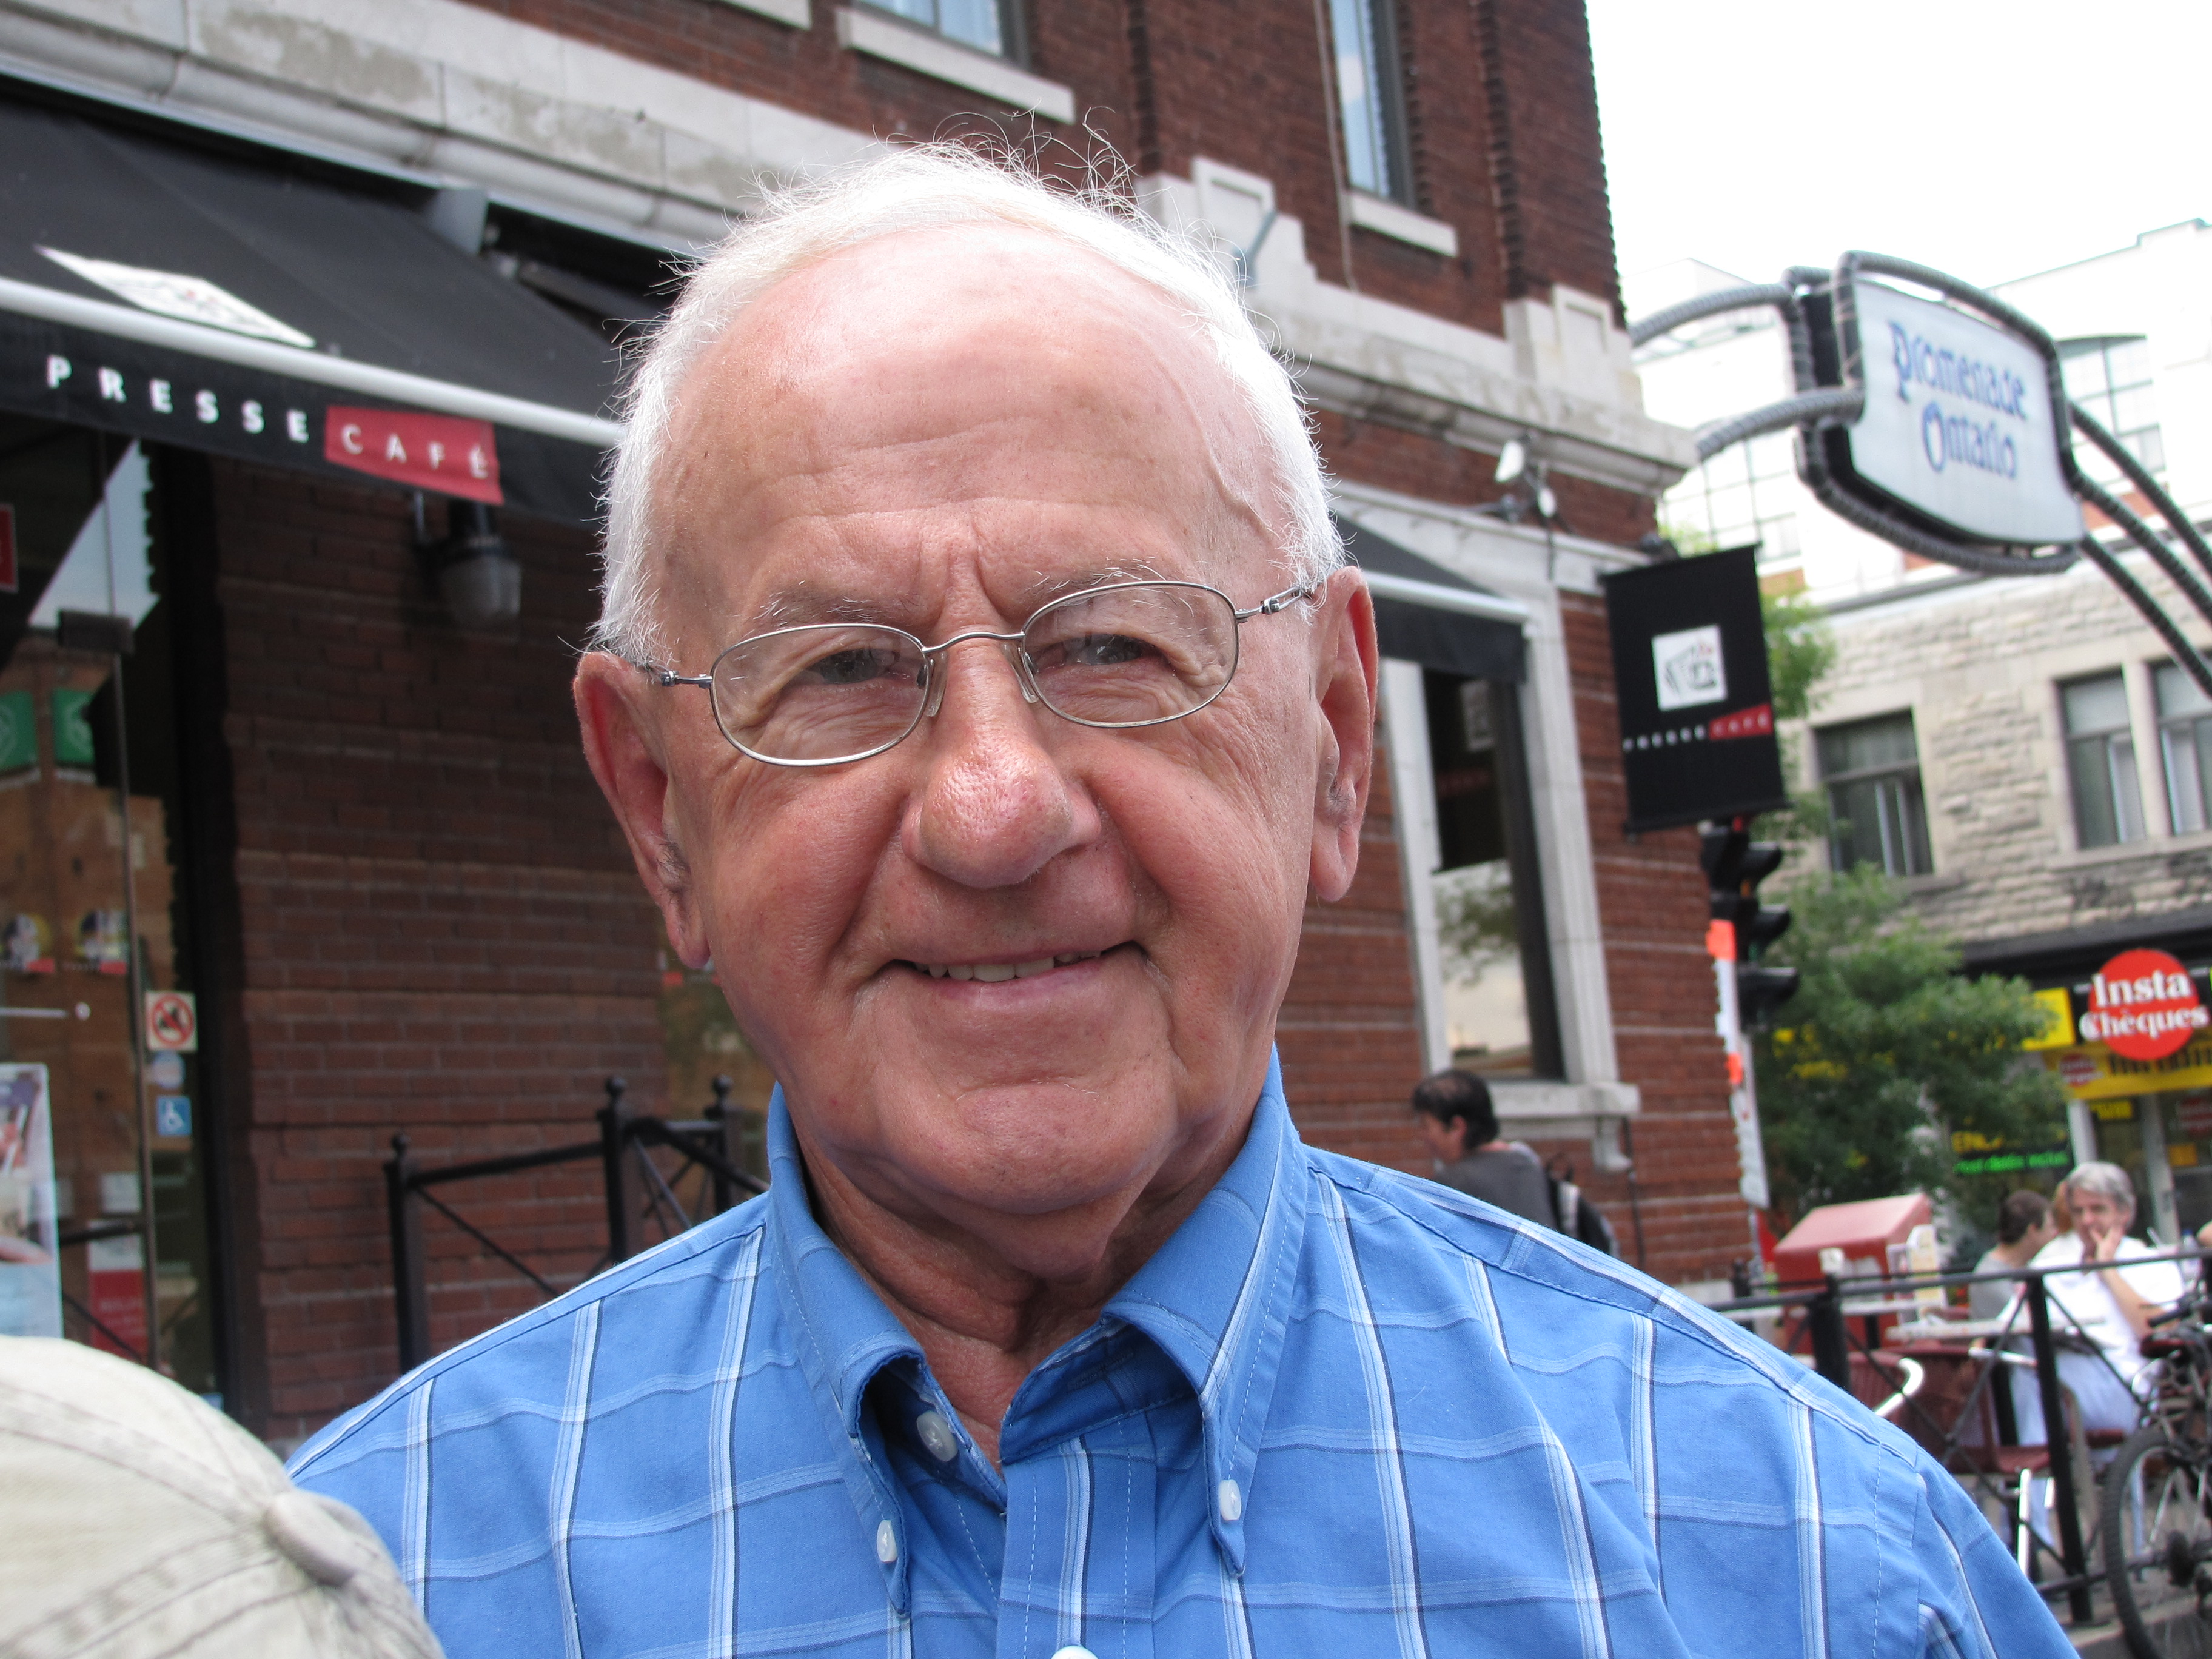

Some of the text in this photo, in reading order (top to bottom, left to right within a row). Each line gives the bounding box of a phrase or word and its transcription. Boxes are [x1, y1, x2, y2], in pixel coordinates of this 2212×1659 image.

[46, 354, 488, 480] PRESSE CAFÉ
[2092, 969, 2192, 1007] Insta
[2078, 1004, 2210, 1042] Chèques
